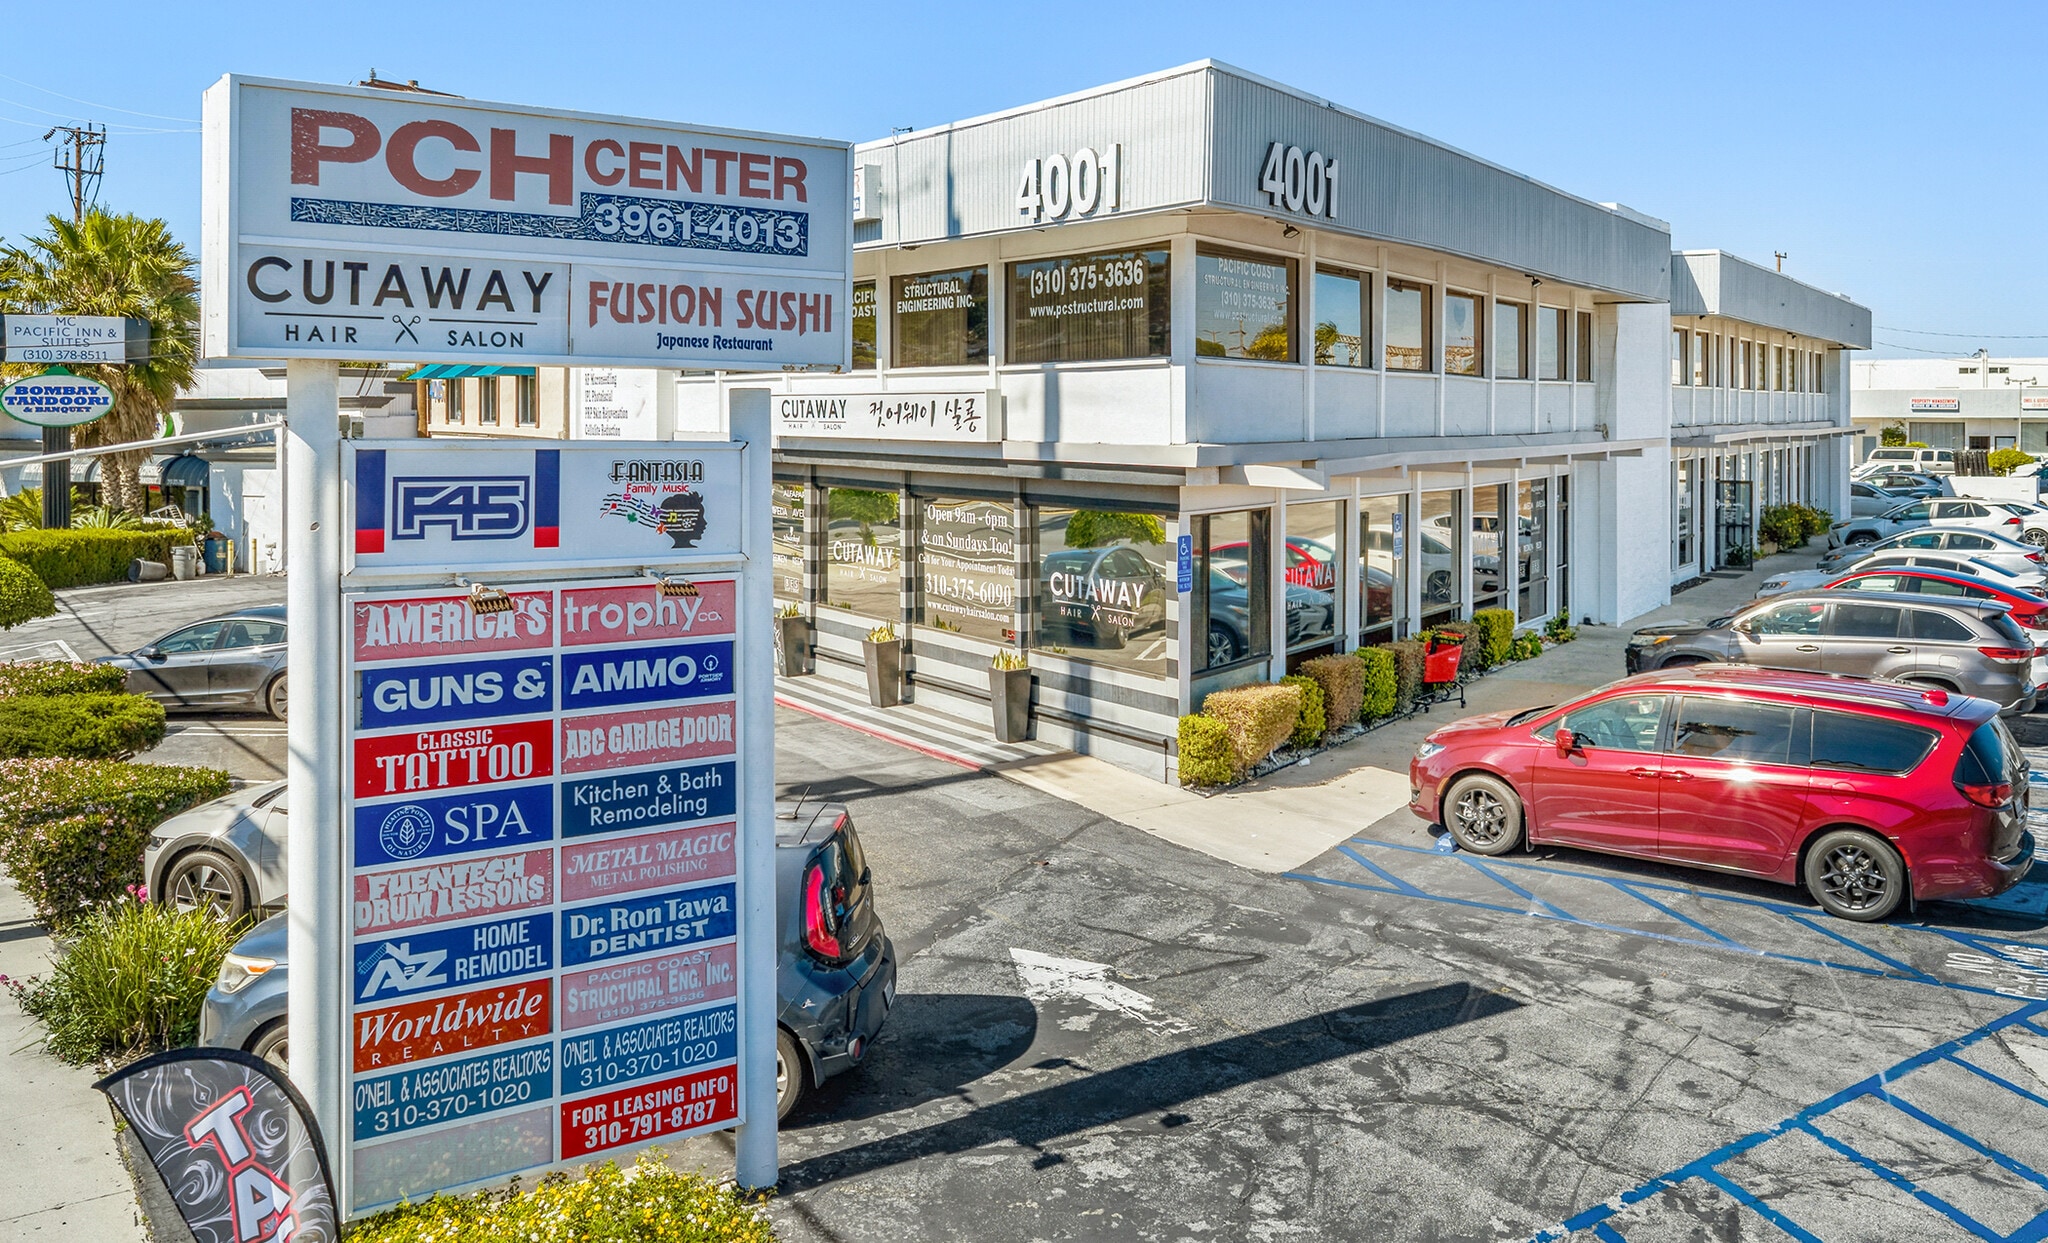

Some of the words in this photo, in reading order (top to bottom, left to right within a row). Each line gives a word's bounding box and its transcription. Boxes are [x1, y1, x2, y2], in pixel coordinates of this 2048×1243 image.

[291, 107, 573, 206] PCH
[585, 138, 808, 203] CENTER
[1015, 143, 1121, 223] 4001
[1259, 142, 1338, 219] 4001
[594, 202, 801, 251] 3961-4013
[247, 256, 554, 313] CUTAWAY
[1030, 267, 1066, 298] (310)
[1070, 259, 1144, 292] 375-3636
[1219, 258, 1249, 276] PACIFIC
[1251, 263, 1276, 279] COAST
[897, 296, 954, 314] ENGINEERING
[956, 292, 976, 309] INC.
[904, 280, 961, 298] STRUCTURAL
[1222, 291, 1241, 308] (310)
[56, 317, 76, 327] MC
[589, 281, 723, 327] FUSION
[737, 289, 832, 334] SUSHI
[1029, 296, 1144, 319] www.pcstructural.com
[14, 327, 71, 337] PACIFIC
[77, 328, 102, 337] INN
[108, 328, 117, 338] &
[42, 337, 90, 347] SUITES
[286, 324, 358, 344] HAIR
[448, 330, 524, 348] SALON
[657, 332, 710, 352] Japanese
[713, 335, 773, 352] Restaurant
[23, 350, 53, 361] (310)
[56, 350, 108, 361] 378-8511
[5, 396, 109, 406] TANDOORI
[14, 386, 100, 396] BOMBAY
[781, 400, 847, 418] CUTAWAY
[608, 459, 704, 484] FANTASIA
[626, 483, 658, 495] Family
[662, 483, 689, 492] Music
[392, 476, 530, 541] F45
[927, 504, 952, 524] Open
[955, 507, 976, 524] 9am
[985, 510, 1007, 530] 6pm
[833, 541, 893, 568] CUTAWAY
[921, 529, 930, 544] &
[932, 534, 944, 546] on
[947, 532, 987, 555] Sundays
[990, 537, 1013, 555] Too!
[918, 553, 930, 564] Call
[931, 554, 939, 565] for
[941, 556, 955, 568] Your
[956, 559, 996, 574] Appointment
[925, 573, 1012, 607] 310-375-6090
[1050, 572, 1144, 608] CUTAWAY
[361, 597, 550, 648] AMERICA'S
[564, 591, 704, 636] trophy
[927, 600, 1010, 623] www.cutawayhairsalon.com
[1061, 606, 1082, 618] HAIR
[1108, 614, 1134, 627] SALON
[373, 671, 503, 713] GUNS
[513, 668, 547, 700] &
[571, 656, 697, 696] AMMO
[416, 729, 493, 751] CLASSIC
[563, 728, 606, 762] ABC
[608, 717, 682, 754] GARAGE
[682, 713, 734, 747] DOOR
[375, 742, 533, 793] TATTOO
[574, 780, 648, 806] Kitchen
[657, 774, 672, 795] &
[680, 767, 722, 791] Bath
[445, 800, 531, 846] SPA
[590, 794, 707, 826] Remodeling
[567, 843, 653, 875] METAL
[656, 832, 732, 861] MAGIC
[591, 870, 637, 888] METAL
[640, 858, 707, 882] POLISHING
[355, 892, 435, 928] DRUM
[437, 874, 545, 917] LESSONS
[570, 914, 606, 939] Dr.
[610, 906, 661, 933] Ron
[664, 895, 731, 921] Tawa
[474, 920, 530, 951] HOME
[590, 918, 710, 958] DENTIST
[455, 945, 547, 981] REMODEL
[588, 964, 653, 985] PACIFIC
[657, 951, 712, 971] COAST
[567, 977, 664, 1013] STRUCTURAL
[668, 968, 702, 994] ENG.
[705, 962, 734, 987] INC.
[359, 988, 543, 1049] Worldwide
[596, 1005, 635, 1021] (310)
[640, 990, 705, 1011] 375-3636
[372, 1023, 532, 1065] REALTY
[563, 1039, 597, 1068] O'NEIL
[603, 1035, 611, 1059] &
[614, 1021, 681, 1057] ASSOCIATES
[684, 1010, 735, 1041] REALTORS
[356, 1080, 395, 1112] O'NEIL
[400, 1076, 410, 1102] &
[413, 1060, 490, 1099] ASSOCIATES
[493, 1048, 551, 1083] REALTORS
[580, 1040, 718, 1087] 310-370-1020
[374, 1081, 531, 1132] 310-370-1020
[572, 1104, 607, 1127] FOR
[613, 1085, 685, 1118] LEASING
[691, 1075, 729, 1101] INFO
[585, 1098, 716, 1149] 310-791-8787
